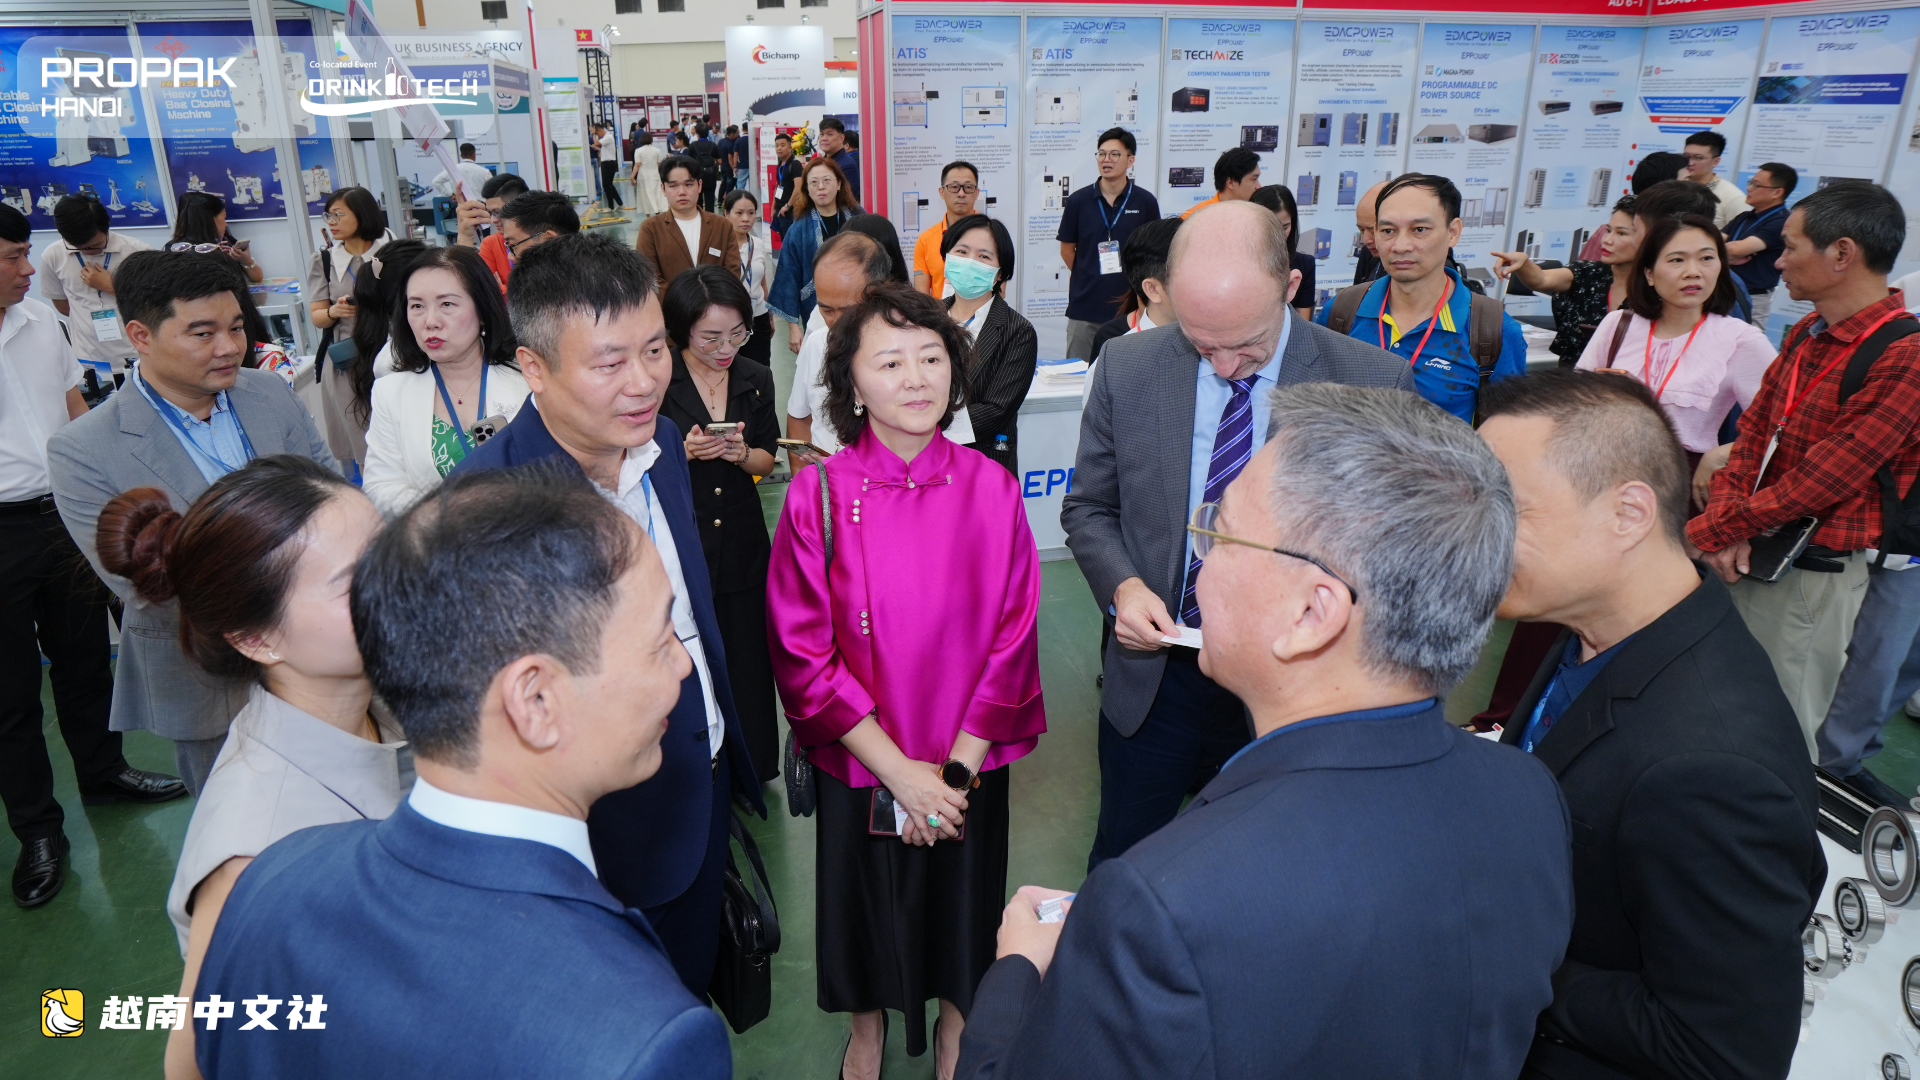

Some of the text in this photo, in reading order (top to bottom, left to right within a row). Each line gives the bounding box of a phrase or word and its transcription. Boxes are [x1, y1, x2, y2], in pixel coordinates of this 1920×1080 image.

[915, 19, 983, 29] EDACPOWER
[1063, 21, 1126, 31] EDACPOWER
[1201, 23, 1262, 33] EDACPOWER
[1798, 14, 1891, 32] EDACPOWER
[1324, 26, 1394, 38] EDACPOWER
[1445, 30, 1512, 42] EDACPOWER
[1566, 29, 1617, 39] EDACPOWER
[1668, 25, 1739, 40] EDACPOWER
[394, 42, 523, 53] UK BUSINESS AGENCY
[762, 52, 800, 61] Bichamp
[1343, 49, 1374, 57] EPPower
[463, 71, 487, 79] AF2-5
[1421, 81, 1498, 89] PROGRAMMABLE DC
[163, 88, 228, 99] Heavy Duty
[1420, 91, 1481, 99] POWER SOURCE
[165, 99, 232, 110] Bag Closing
[167, 110, 213, 120] Machine
